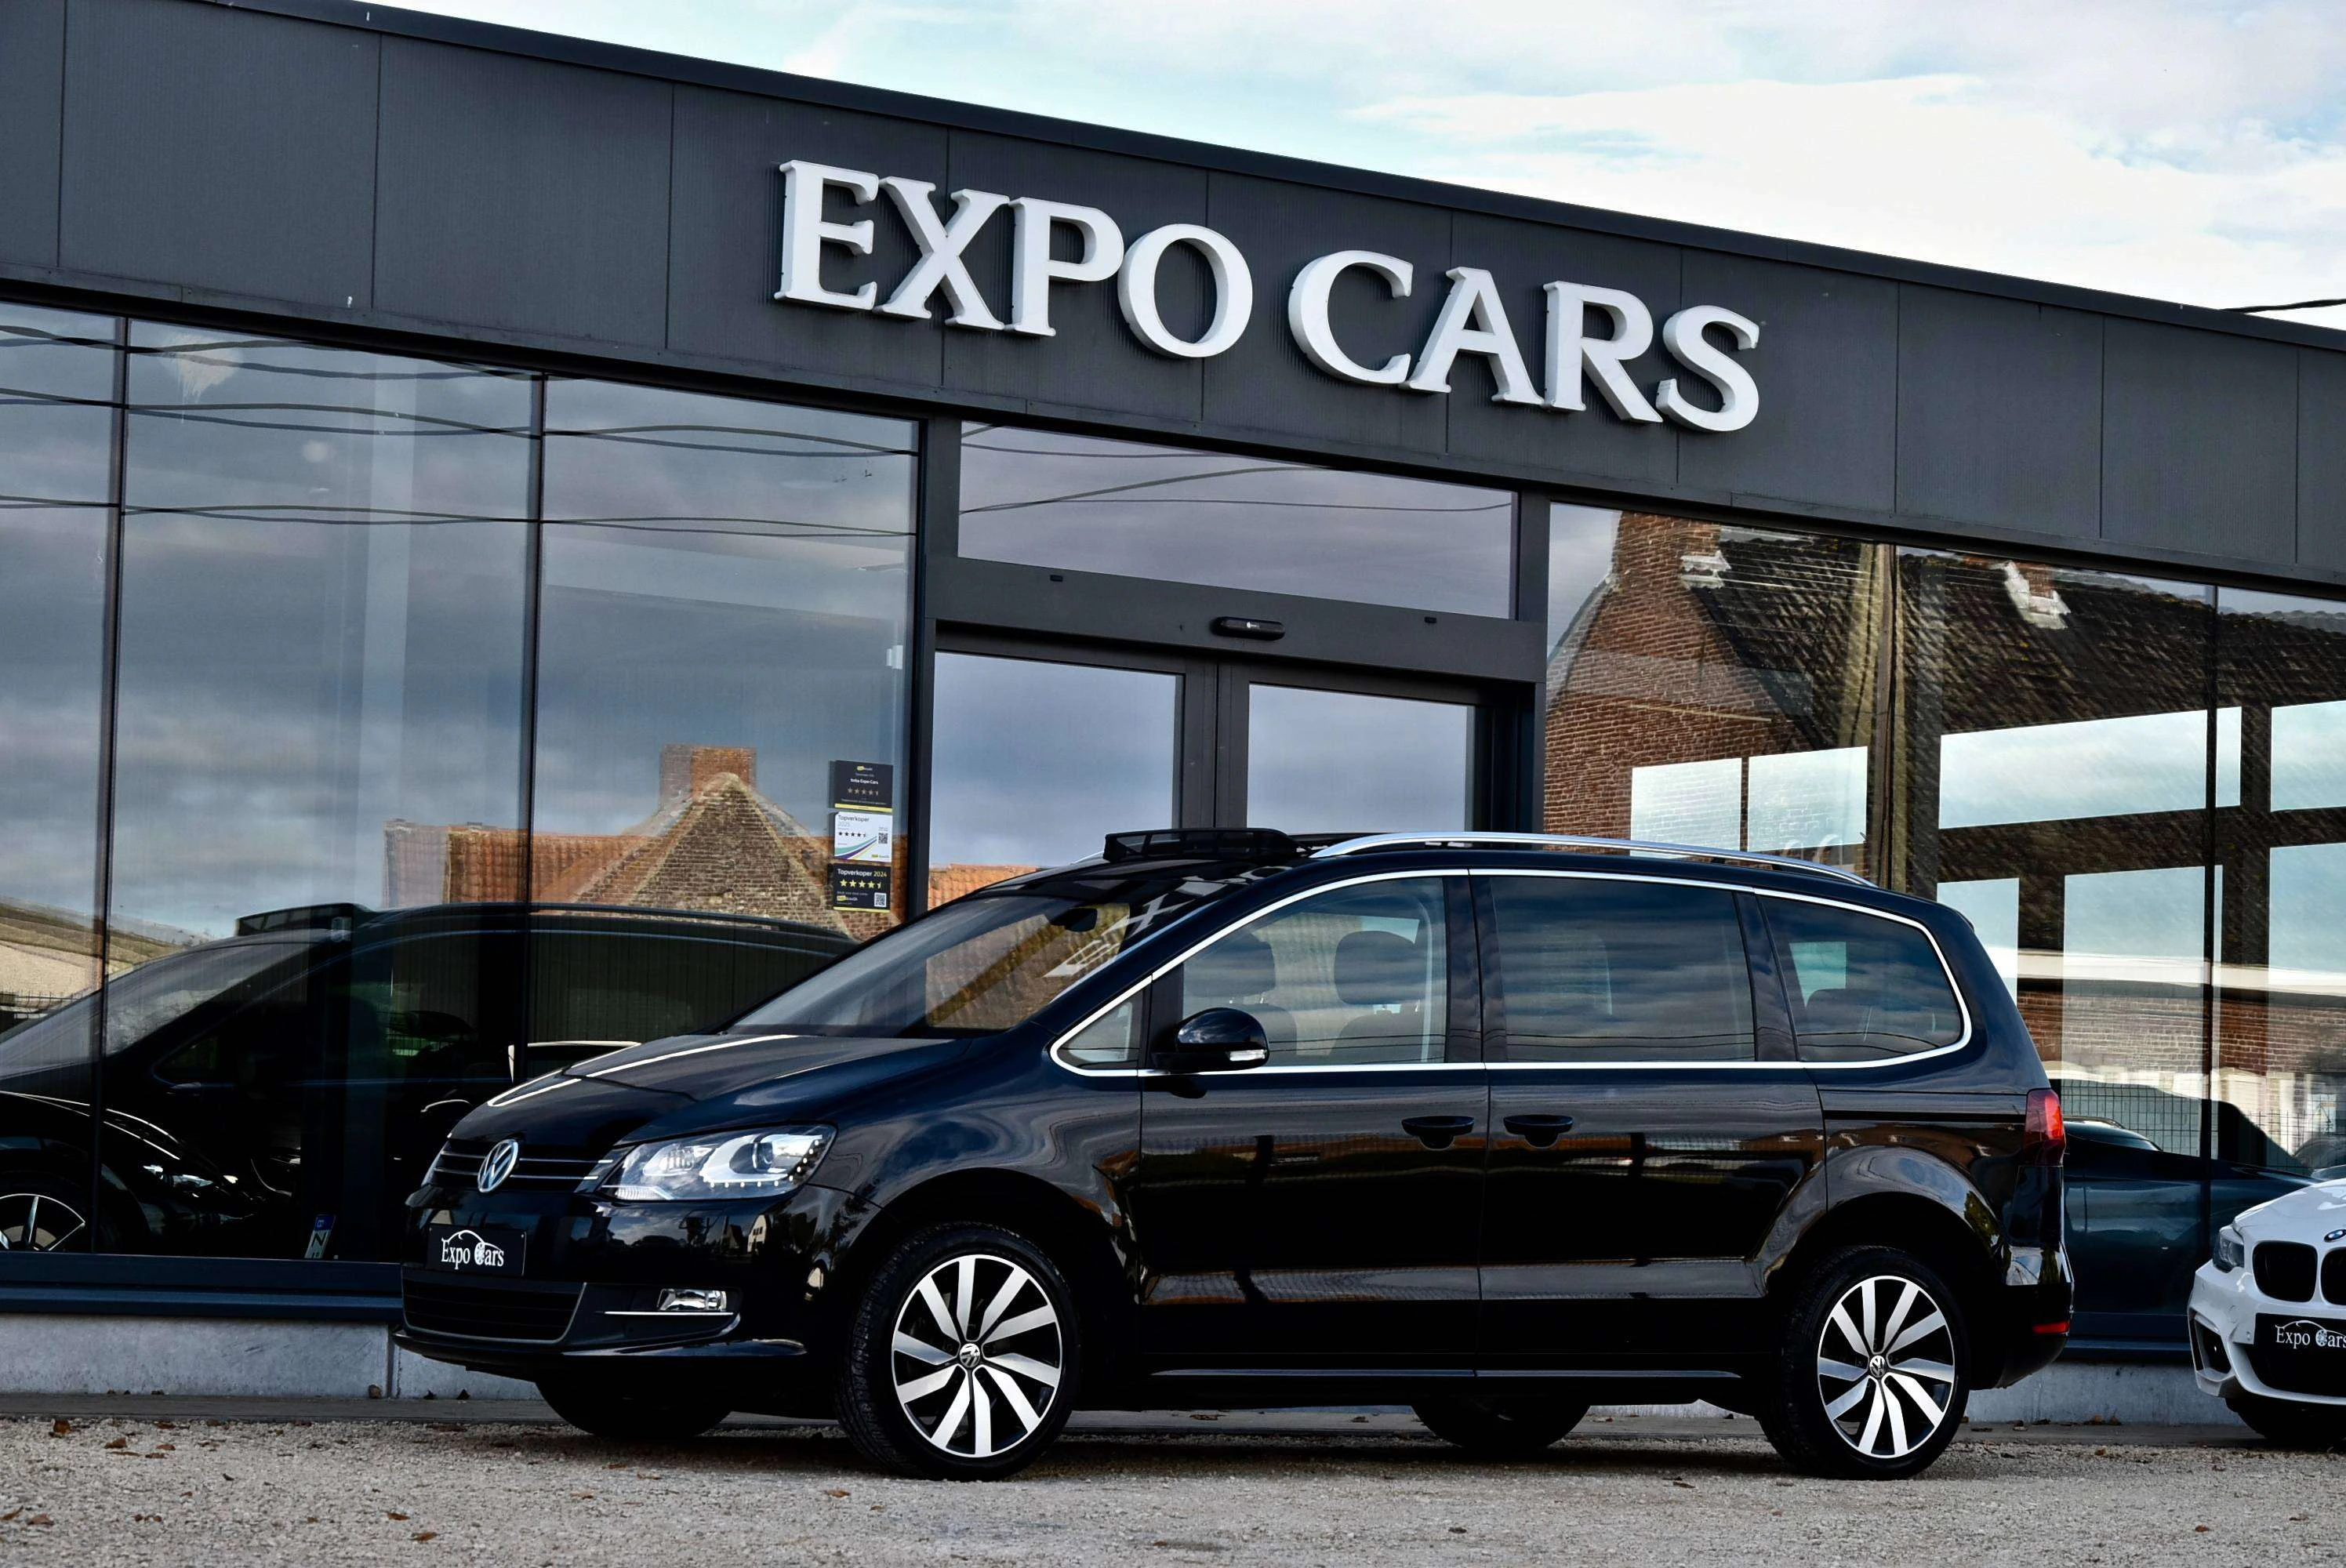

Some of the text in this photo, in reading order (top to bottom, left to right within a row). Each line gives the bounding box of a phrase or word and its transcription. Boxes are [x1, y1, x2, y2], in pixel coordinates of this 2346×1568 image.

[775, 160, 1761, 434] EXPO CARS
[837, 868, 872, 877] Topverkoper
[441, 1238, 505, 1270] Expo Cars
[2275, 1325, 2311, 1349] Expo
